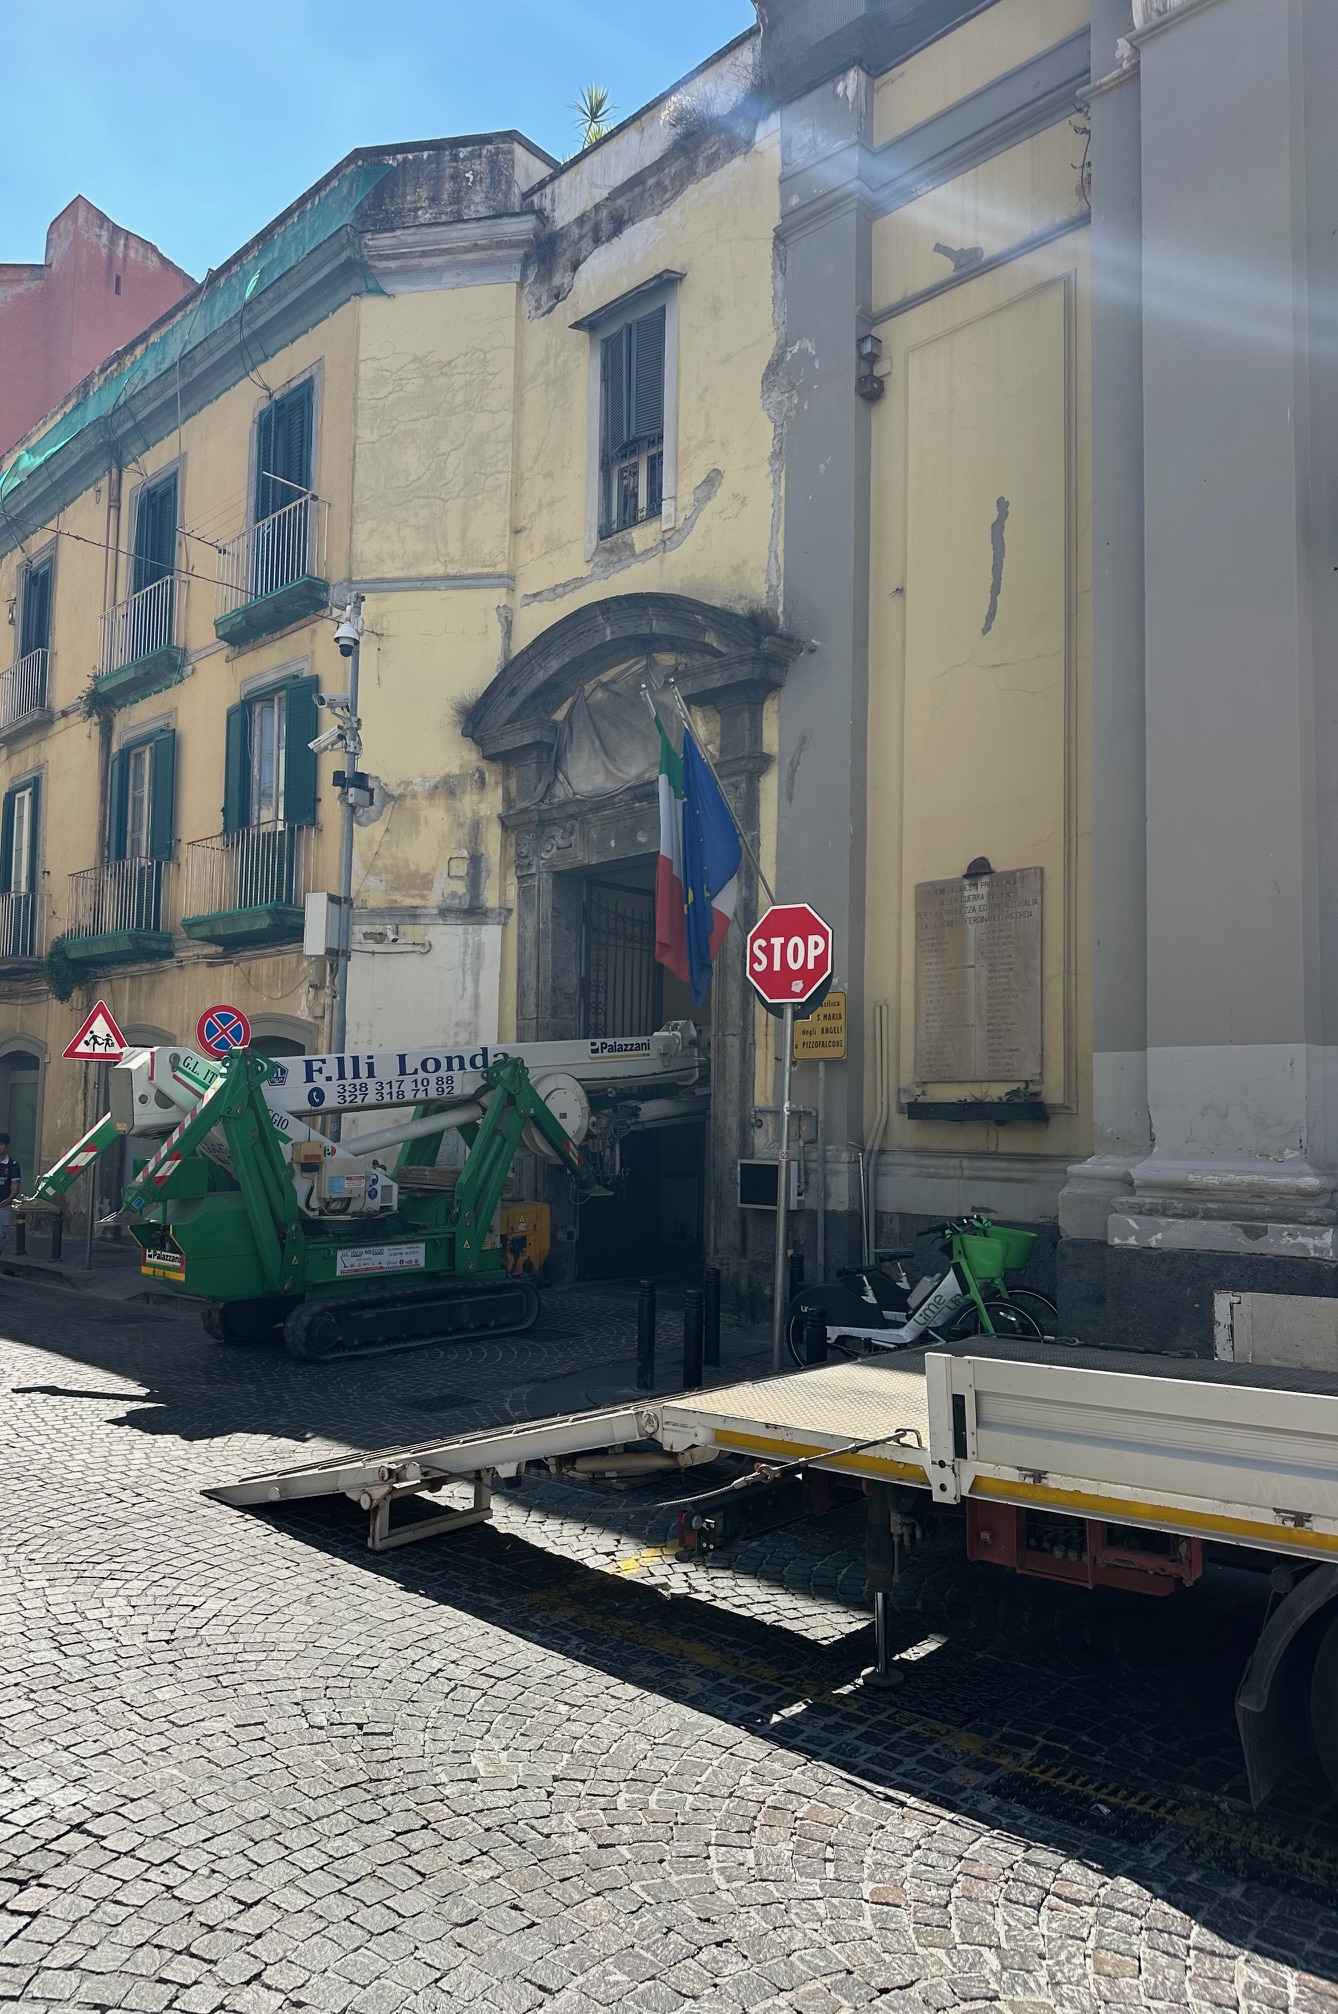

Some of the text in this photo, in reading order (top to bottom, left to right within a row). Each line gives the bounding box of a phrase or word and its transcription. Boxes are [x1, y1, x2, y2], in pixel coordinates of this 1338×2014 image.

[961, 894, 984, 902] GUERRA
[916, 911, 928, 919] PER
[979, 904, 987, 912] ED
[964, 914, 1003, 925] FERDINANDO
[1006, 910, 1032, 920] RICORDA
[753, 934, 825, 972] STOP
[802, 1026, 842, 1037] degli ANGELI
[600, 1039, 650, 1054] Palazzani
[802, 1040, 843, 1049] PIZZOFALCONE
[183, 1056, 199, 1075] G.L.
[302, 1055, 377, 1083] F.lli
[337, 1076, 454, 1094] 338 317 10 88
[337, 1086, 454, 1105] 327 318 71 92
[913, 1294, 946, 1325] Lime
